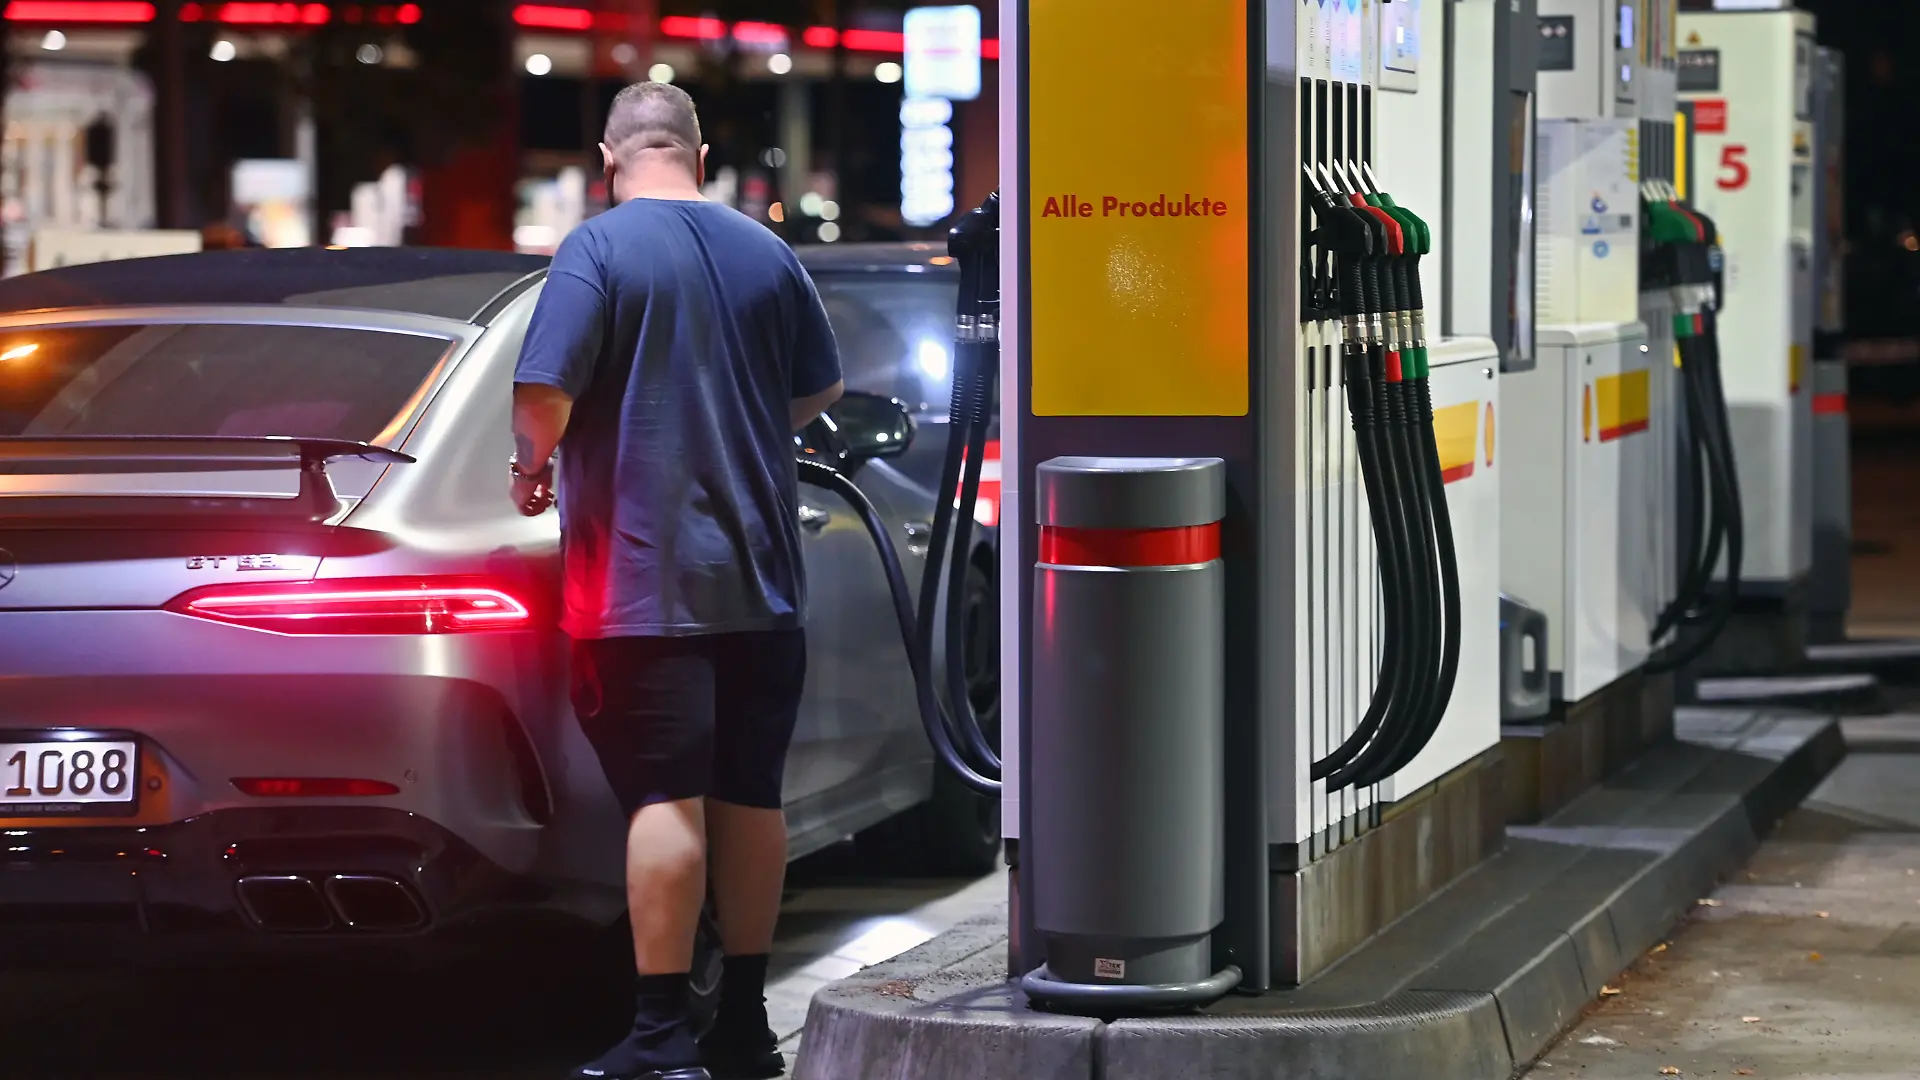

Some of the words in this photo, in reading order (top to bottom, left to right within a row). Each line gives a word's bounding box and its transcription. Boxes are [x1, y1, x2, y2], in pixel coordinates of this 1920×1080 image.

[1715, 143, 1751, 192] 5
[1041, 194, 1094, 218] Alle
[1102, 193, 1228, 218] Produkte
[5, 749, 128, 797] 1088
